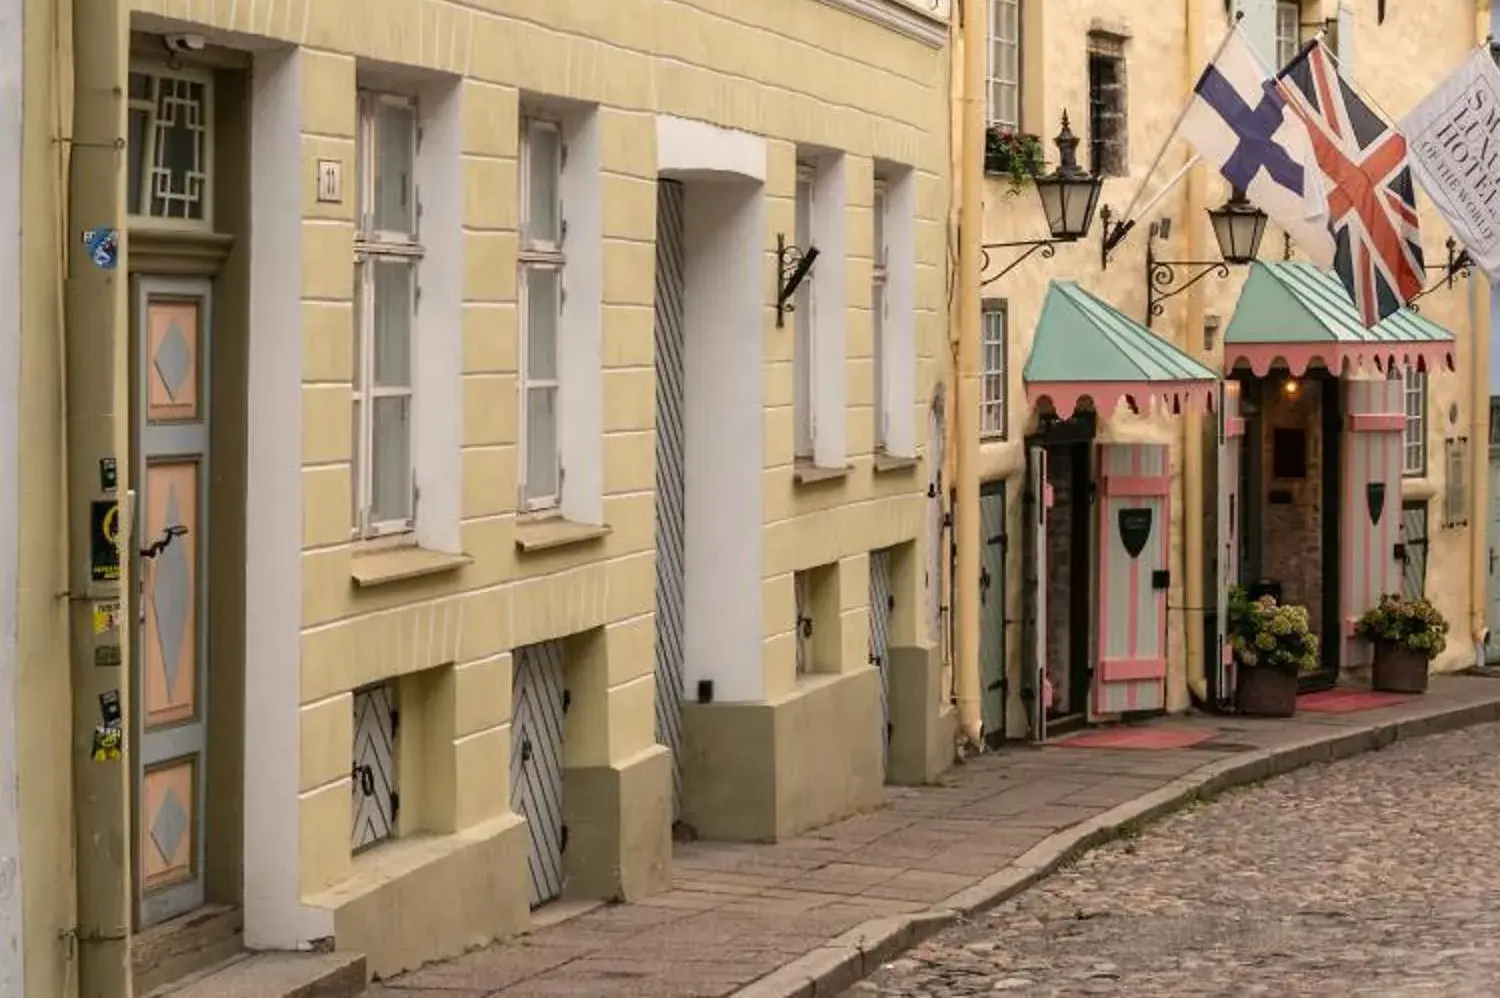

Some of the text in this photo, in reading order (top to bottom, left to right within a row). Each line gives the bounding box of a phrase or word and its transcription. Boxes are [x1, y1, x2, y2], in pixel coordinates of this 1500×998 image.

[1422, 141, 1494, 239] OF THE WORLD
